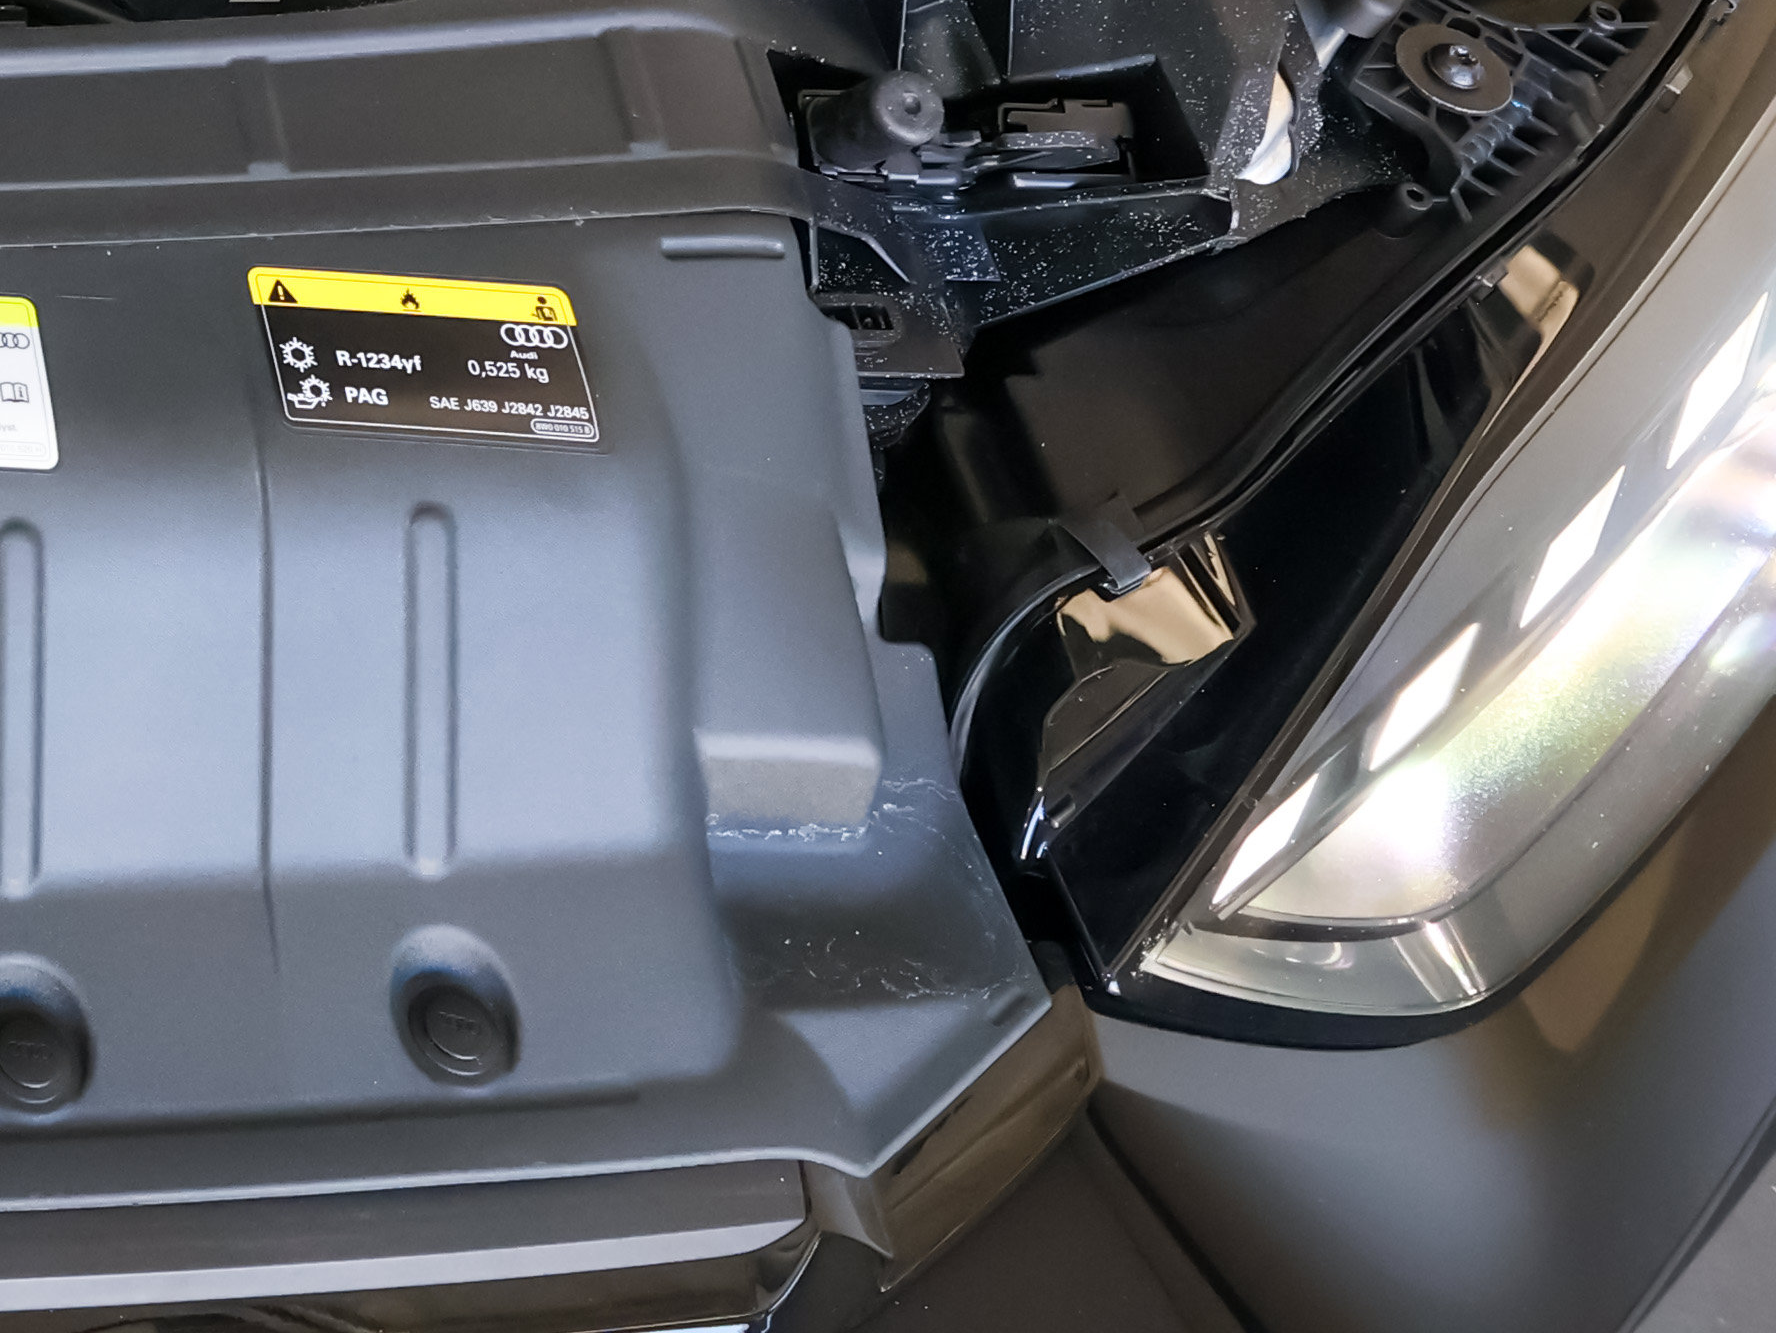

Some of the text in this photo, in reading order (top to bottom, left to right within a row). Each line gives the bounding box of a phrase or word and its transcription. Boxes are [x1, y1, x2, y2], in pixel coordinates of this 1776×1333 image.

[335, 349, 550, 383] R-1234yf 0,525 kg
[509, 350, 538, 361] Audi
[344, 386, 590, 420] PAG SAE J639 J2842 J2845
